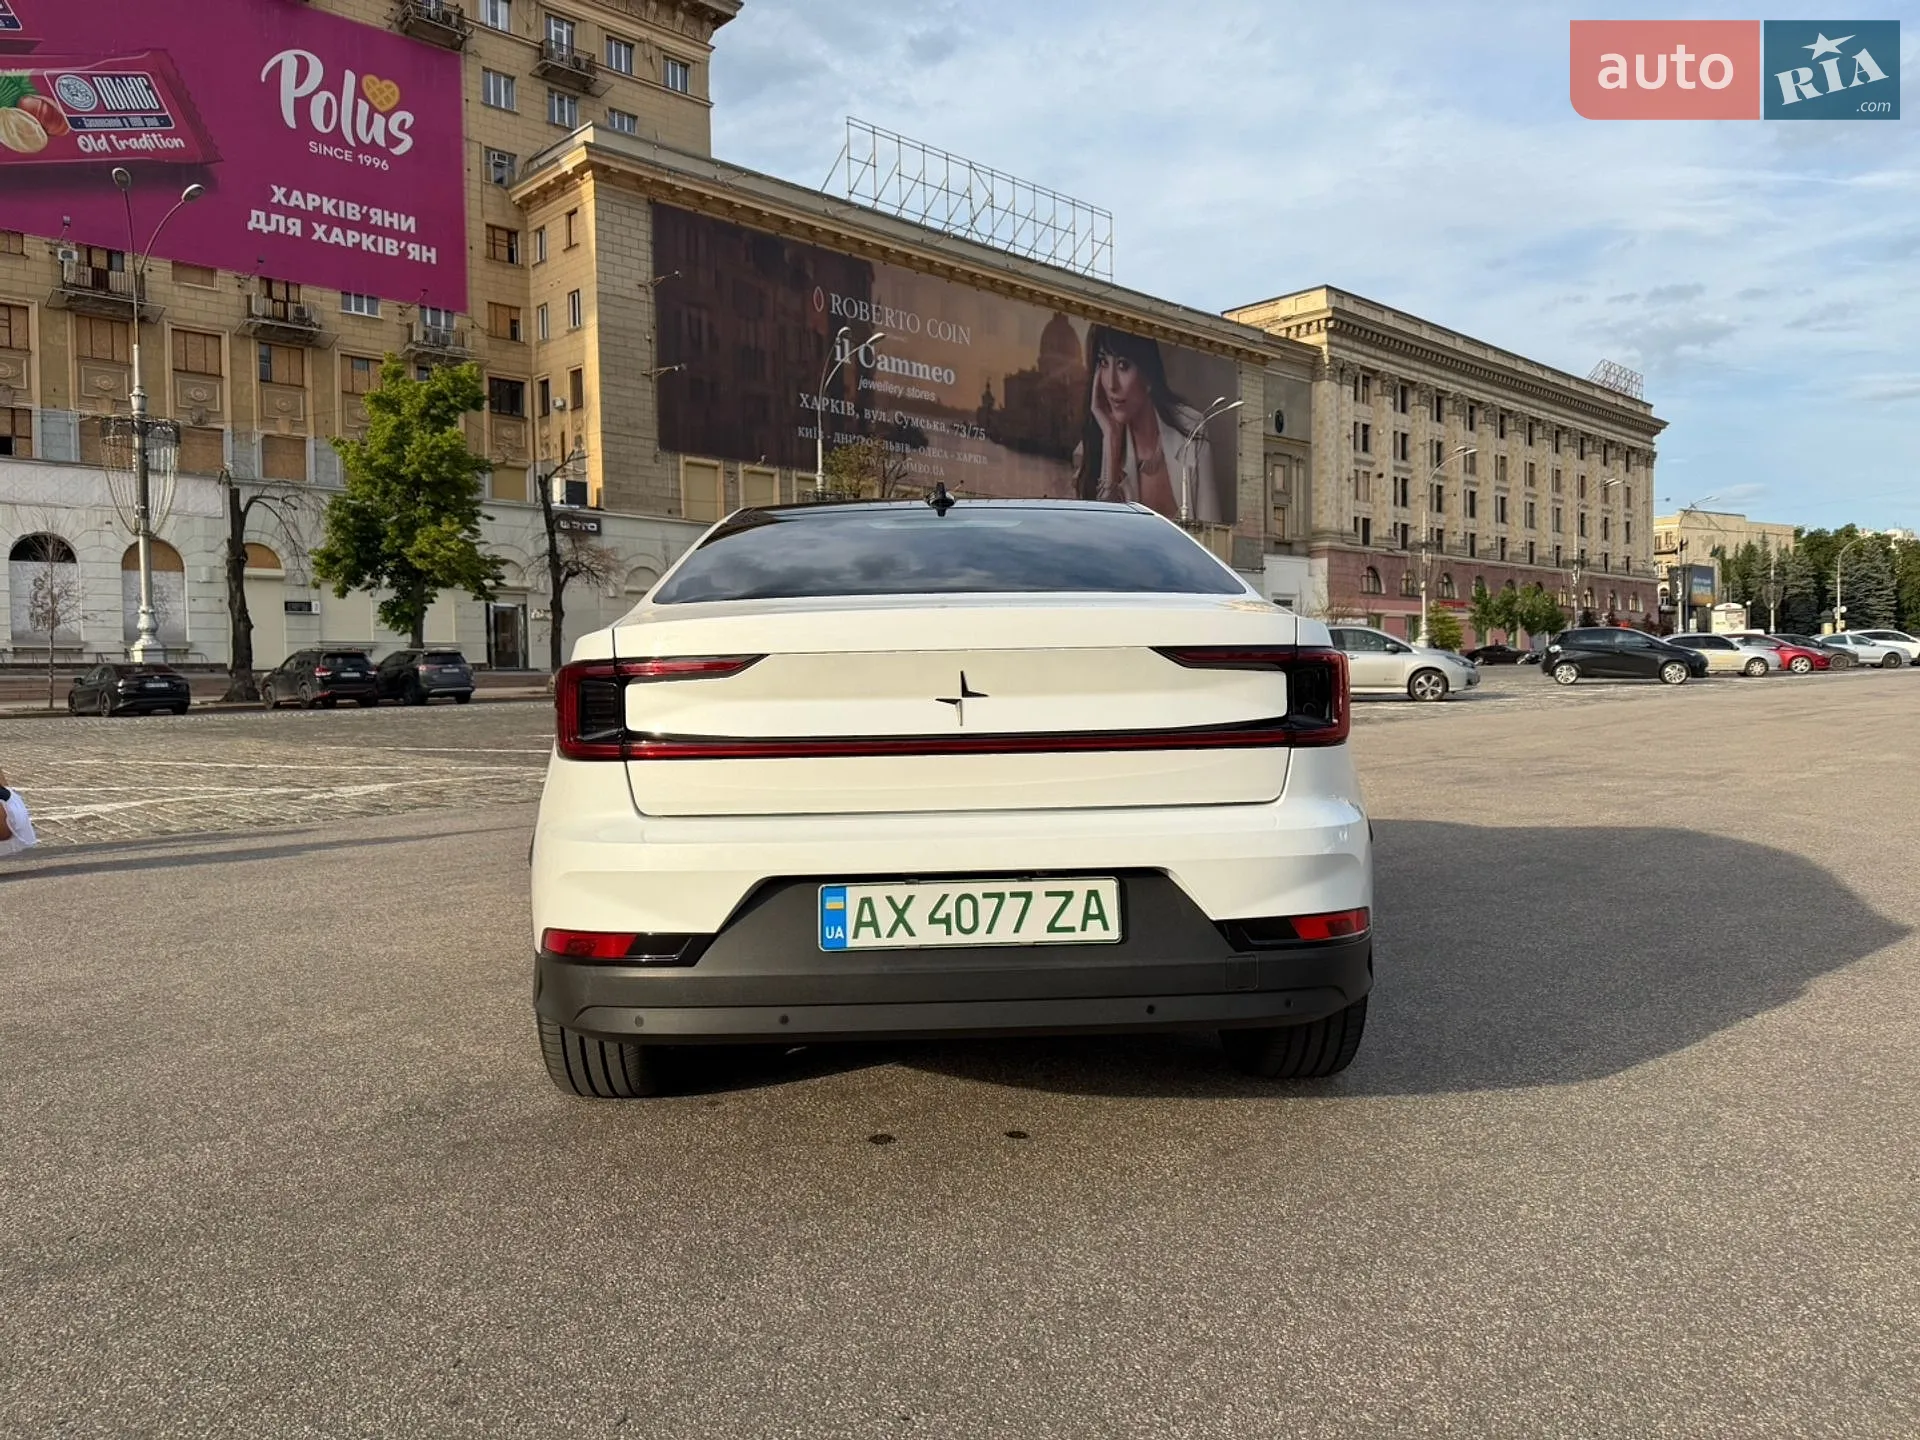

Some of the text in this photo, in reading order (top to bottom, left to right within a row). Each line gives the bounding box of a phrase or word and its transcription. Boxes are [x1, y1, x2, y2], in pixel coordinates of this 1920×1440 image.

[261, 49, 414, 156] Polus
[77, 132, 185, 153] Old tradition
[308, 141, 390, 171] SINCE 1996
[247, 209, 302, 238] ДЛЯ
[830, 293, 971, 346] ROBERTO COIN
[858, 342, 956, 385] Cammeo
[858, 376, 936, 402] jewellery stores
[952, 423, 986, 441] 73/75
[852, 889, 1111, 940] AX 4077 ZA
[825, 925, 845, 939] UA
